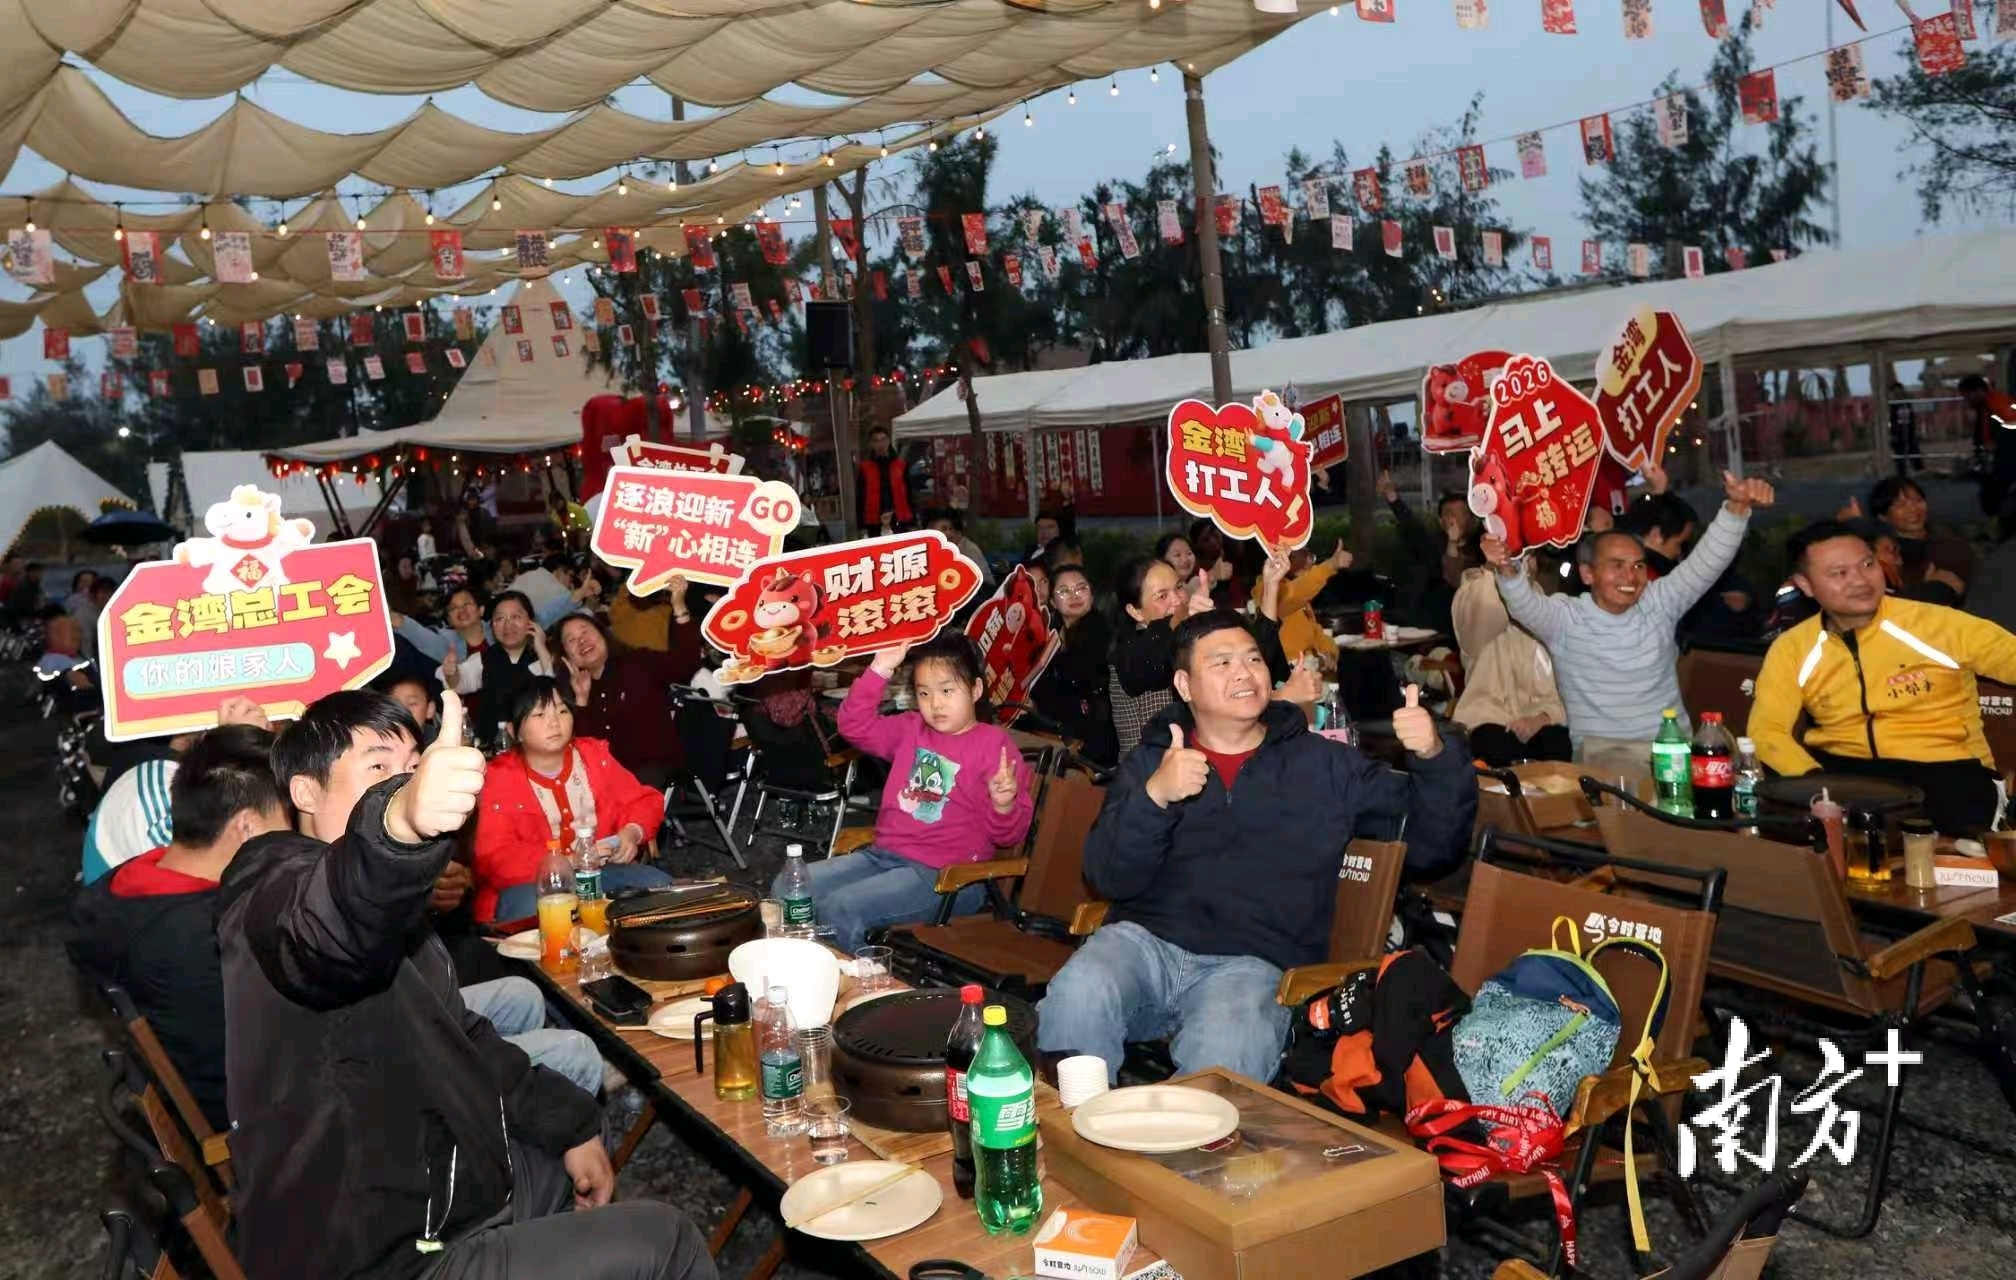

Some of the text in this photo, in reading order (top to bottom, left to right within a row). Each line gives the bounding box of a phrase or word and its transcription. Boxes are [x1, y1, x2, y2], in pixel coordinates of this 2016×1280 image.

[1612, 317, 1646, 379] 金湾
[1497, 363, 1548, 402] 2026
[1616, 349, 1682, 441] 打工人
[1179, 419, 1247, 464] 金湾
[1498, 398, 1563, 459] 马上
[1535, 422, 1598, 487] 转运
[613, 481, 735, 528] 逐浪迎新
[750, 496, 793, 522] GO
[1185, 459, 1283, 510] 打工人
[236, 558, 263, 587] 福
[823, 543, 928, 602] 财源
[119, 574, 375, 646] 金湾总工会
[837, 585, 939, 639] 滚滚
[140, 647, 303, 688] 你的娘家人
